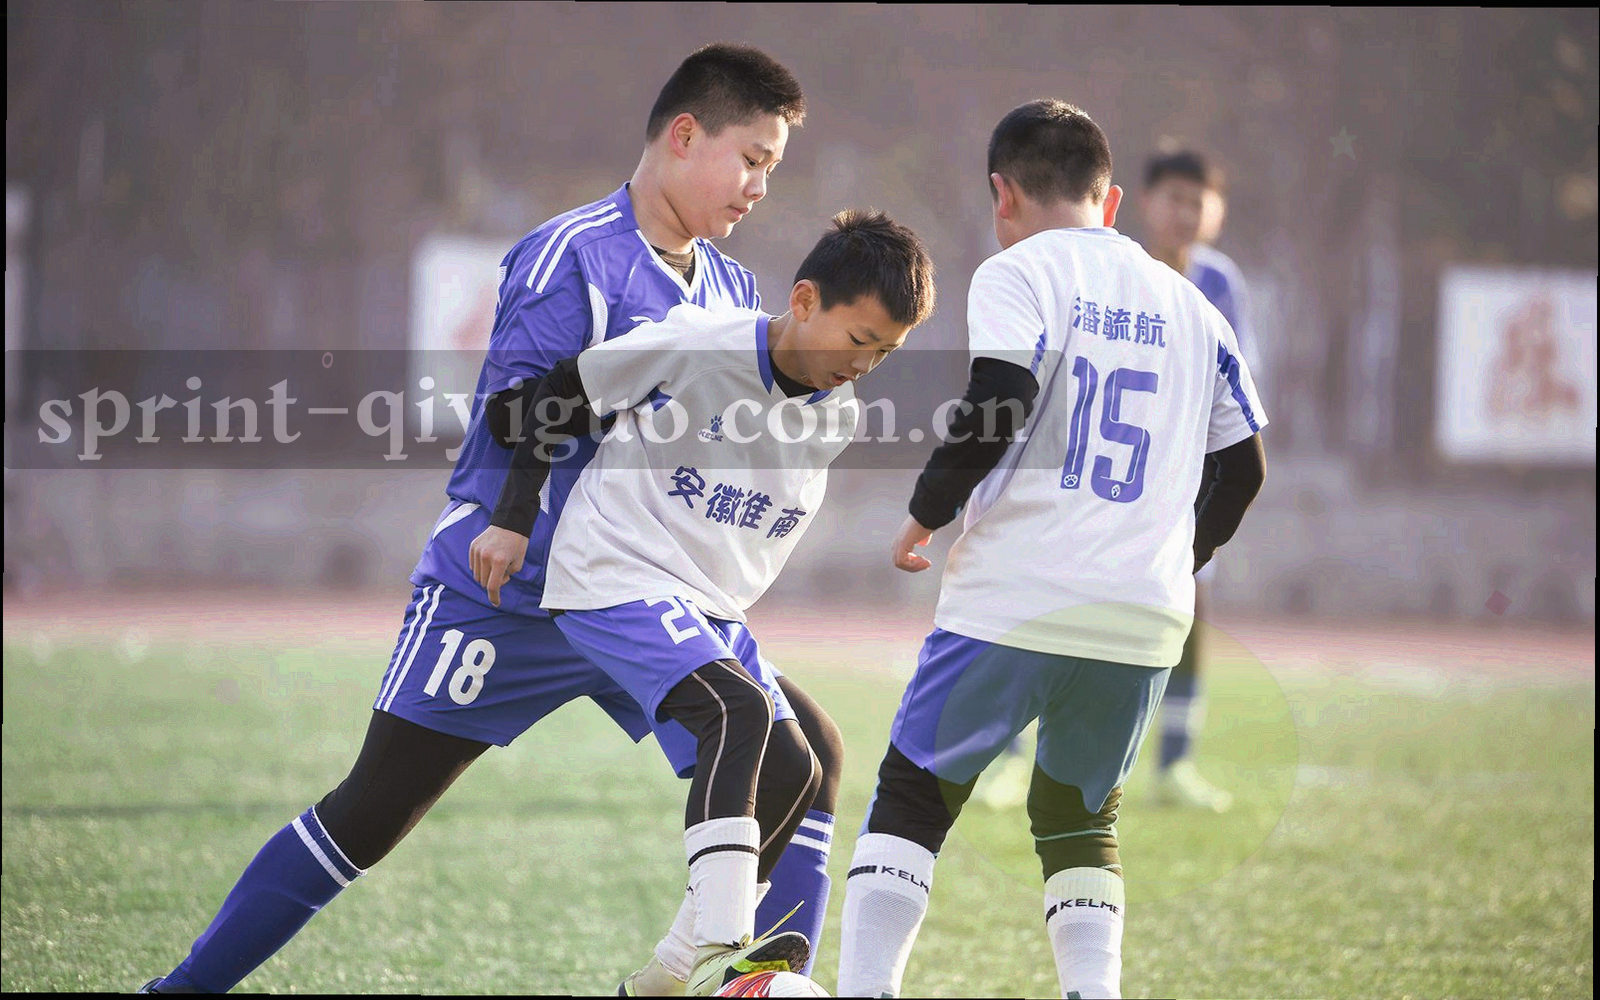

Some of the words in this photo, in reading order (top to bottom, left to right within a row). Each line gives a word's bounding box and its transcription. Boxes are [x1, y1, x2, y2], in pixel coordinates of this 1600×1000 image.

[1072, 296, 1166, 348] 潘毓航
[1060, 355, 1159, 503] 15
[667, 465, 807, 539] 安徽淮南
[423, 628, 497, 706] 18
[1059, 897, 1120, 916] KELME
